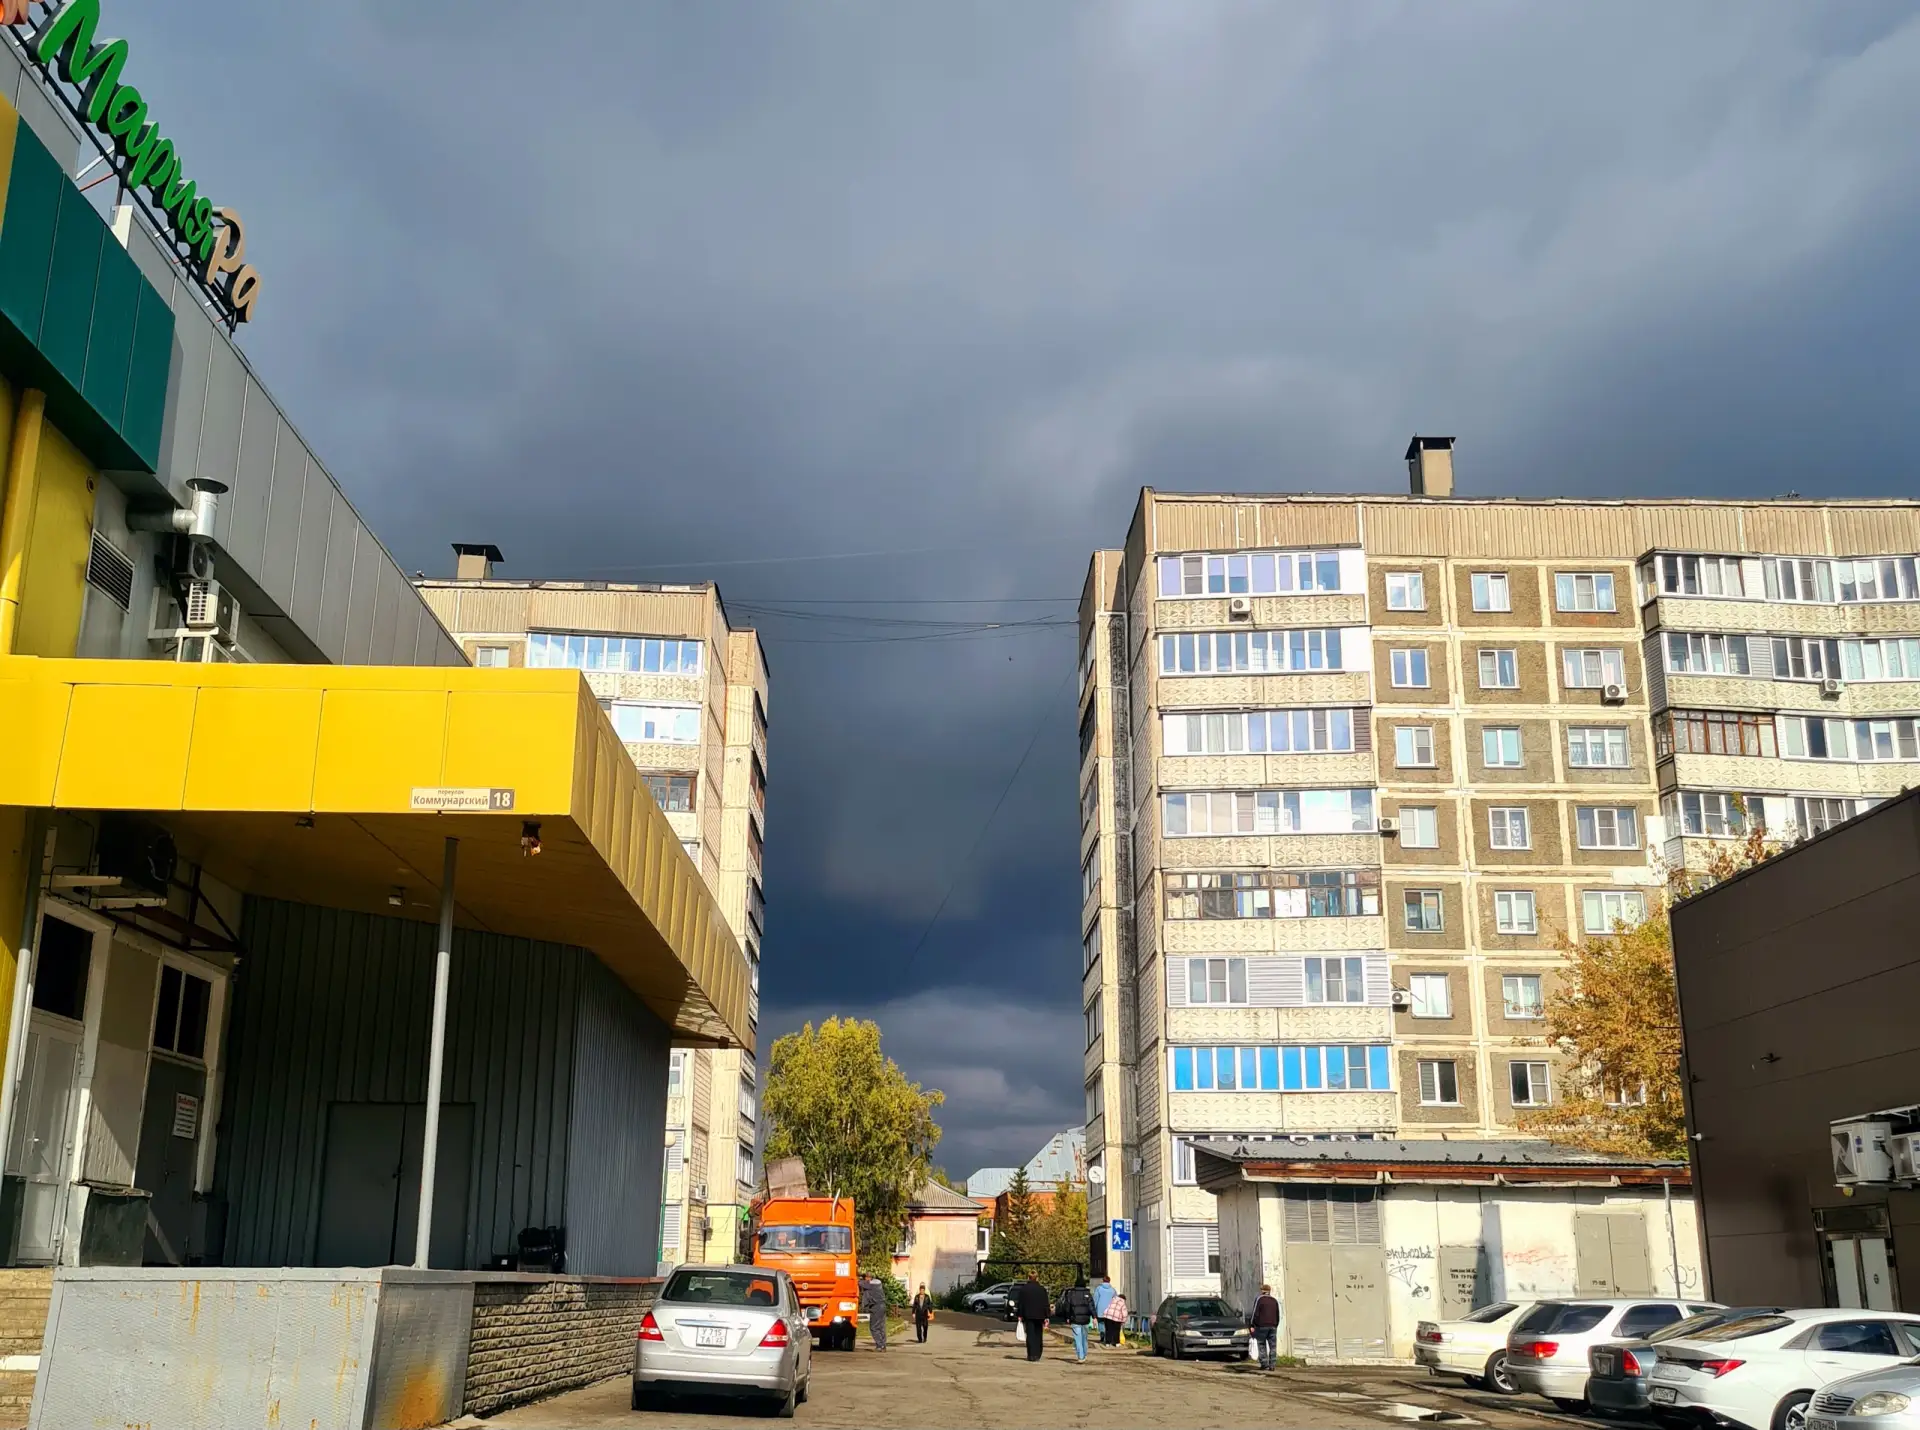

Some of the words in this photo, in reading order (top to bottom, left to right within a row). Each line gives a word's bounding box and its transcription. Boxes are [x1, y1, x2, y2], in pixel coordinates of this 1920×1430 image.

[29, 0, 213, 261] Мария
[413, 795, 489, 807] Коммунарский
[493, 791, 511, 807] 18
